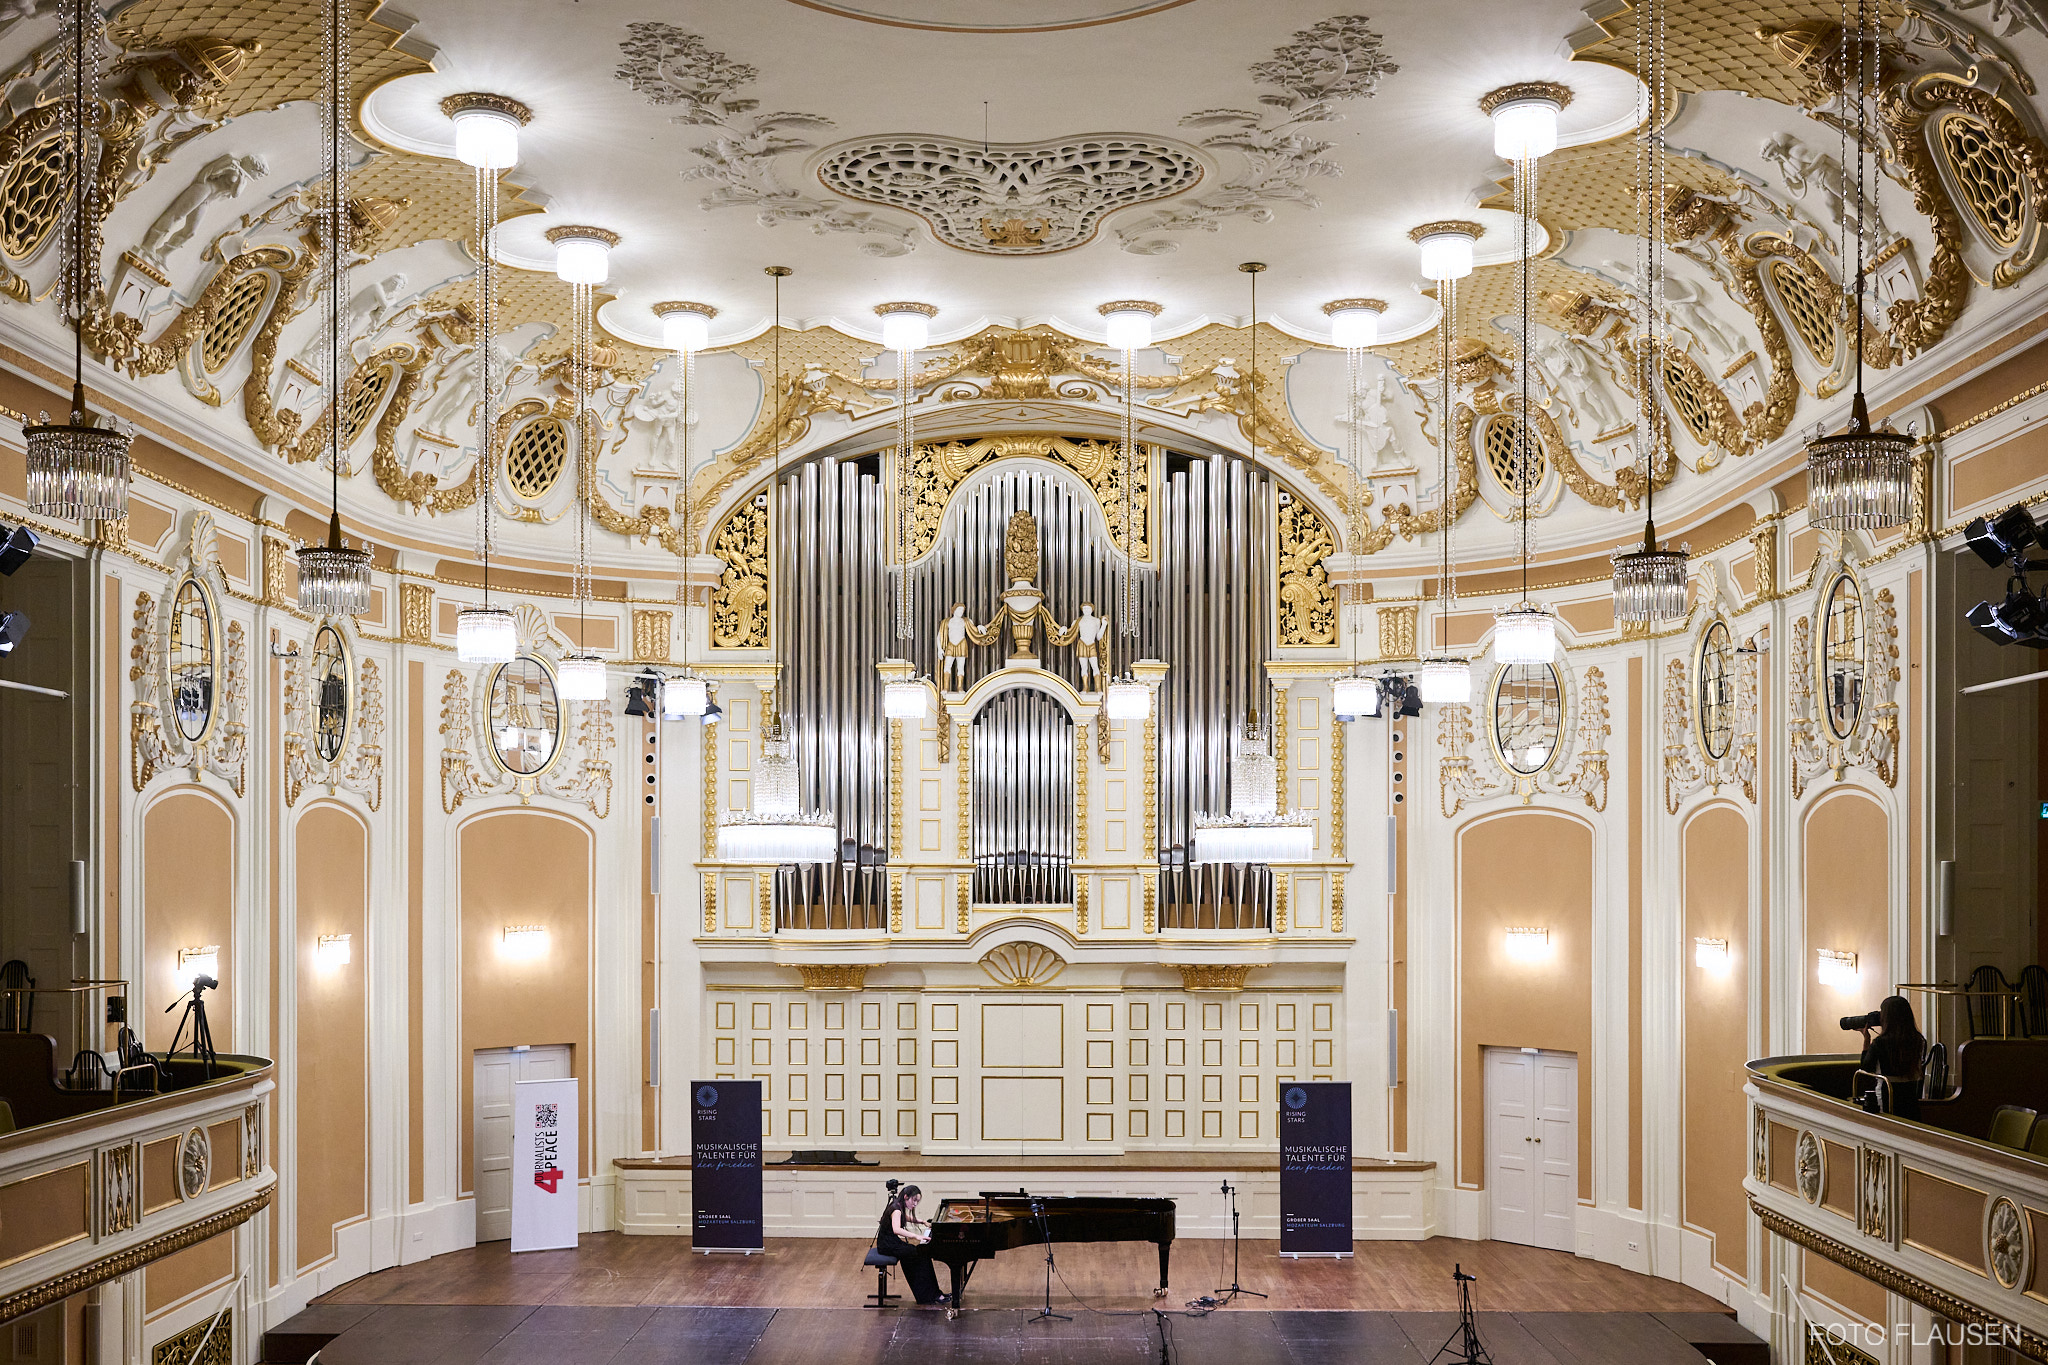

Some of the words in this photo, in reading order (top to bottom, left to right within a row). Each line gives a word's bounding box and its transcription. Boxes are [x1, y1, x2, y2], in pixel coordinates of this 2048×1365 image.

[696, 1143, 758, 1151] MUSIKALISCHE
[1285, 1145, 1347, 1153] MUSIKALISCHE
[534, 1131, 545, 1184] JOURNALISTS
[738, 1150, 756, 1159] FÜR
[1286, 1154, 1325, 1162] TALENTE
[1327, 1153, 1346, 1162] FÜR
[697, 1159, 714, 1168] den
[715, 1159, 755, 1171] frieden
[1286, 1162, 1303, 1171] den
[1304, 1162, 1345, 1174] frieden
